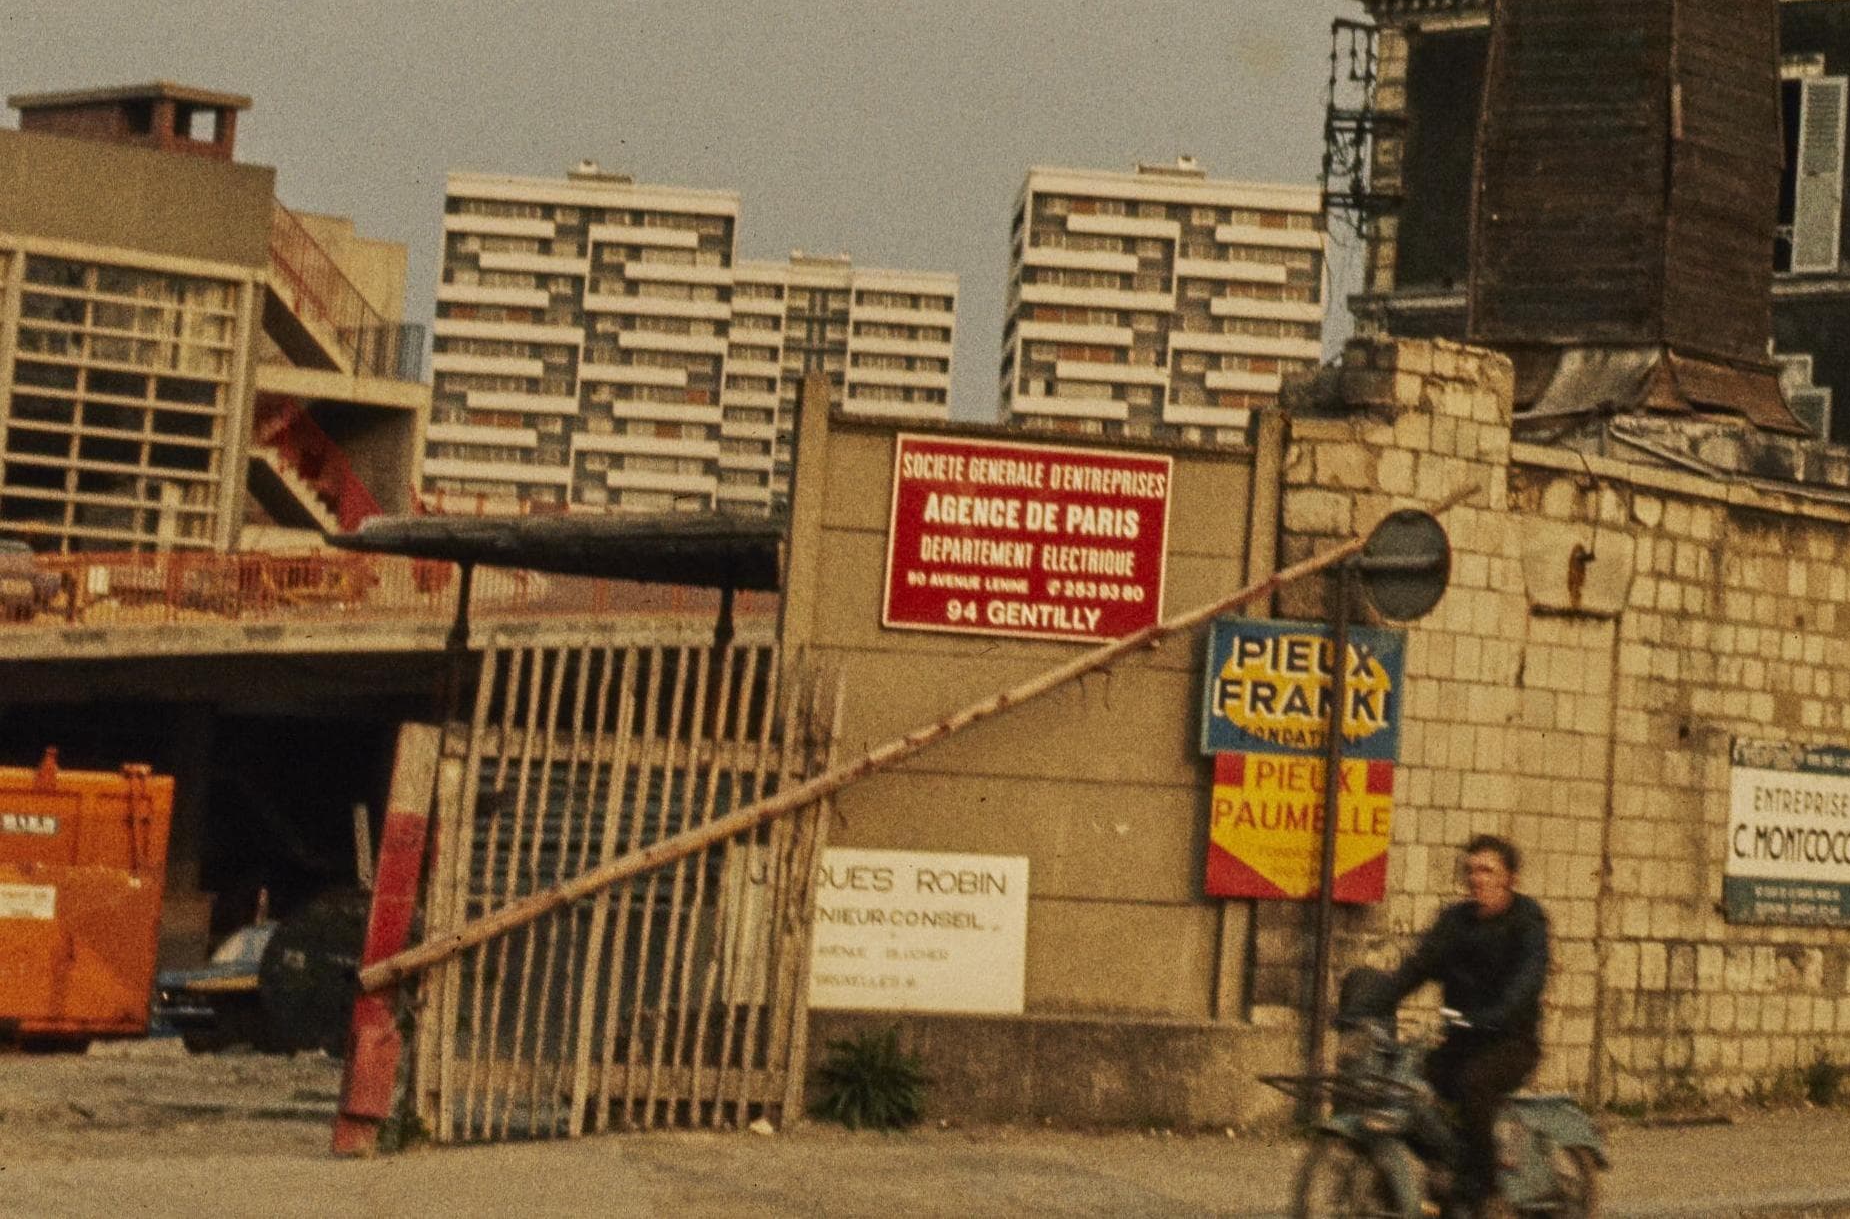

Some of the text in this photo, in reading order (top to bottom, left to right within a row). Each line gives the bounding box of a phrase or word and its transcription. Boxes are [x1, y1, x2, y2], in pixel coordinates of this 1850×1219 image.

[903, 451, 965, 482] SOCIETE
[969, 457, 1045, 489] GENERALE
[924, 492, 1140, 540] AGENCE DE PARIS
[920, 534, 1136, 577] DEPARTEMENT ELECTRIQUE
[947, 599, 1102, 632] 94 GENTILLY
[1754, 784, 1850, 819] ENTREPRISE
[916, 867, 1008, 897] ROBIN
[889, 909, 985, 931] CONSEIL
